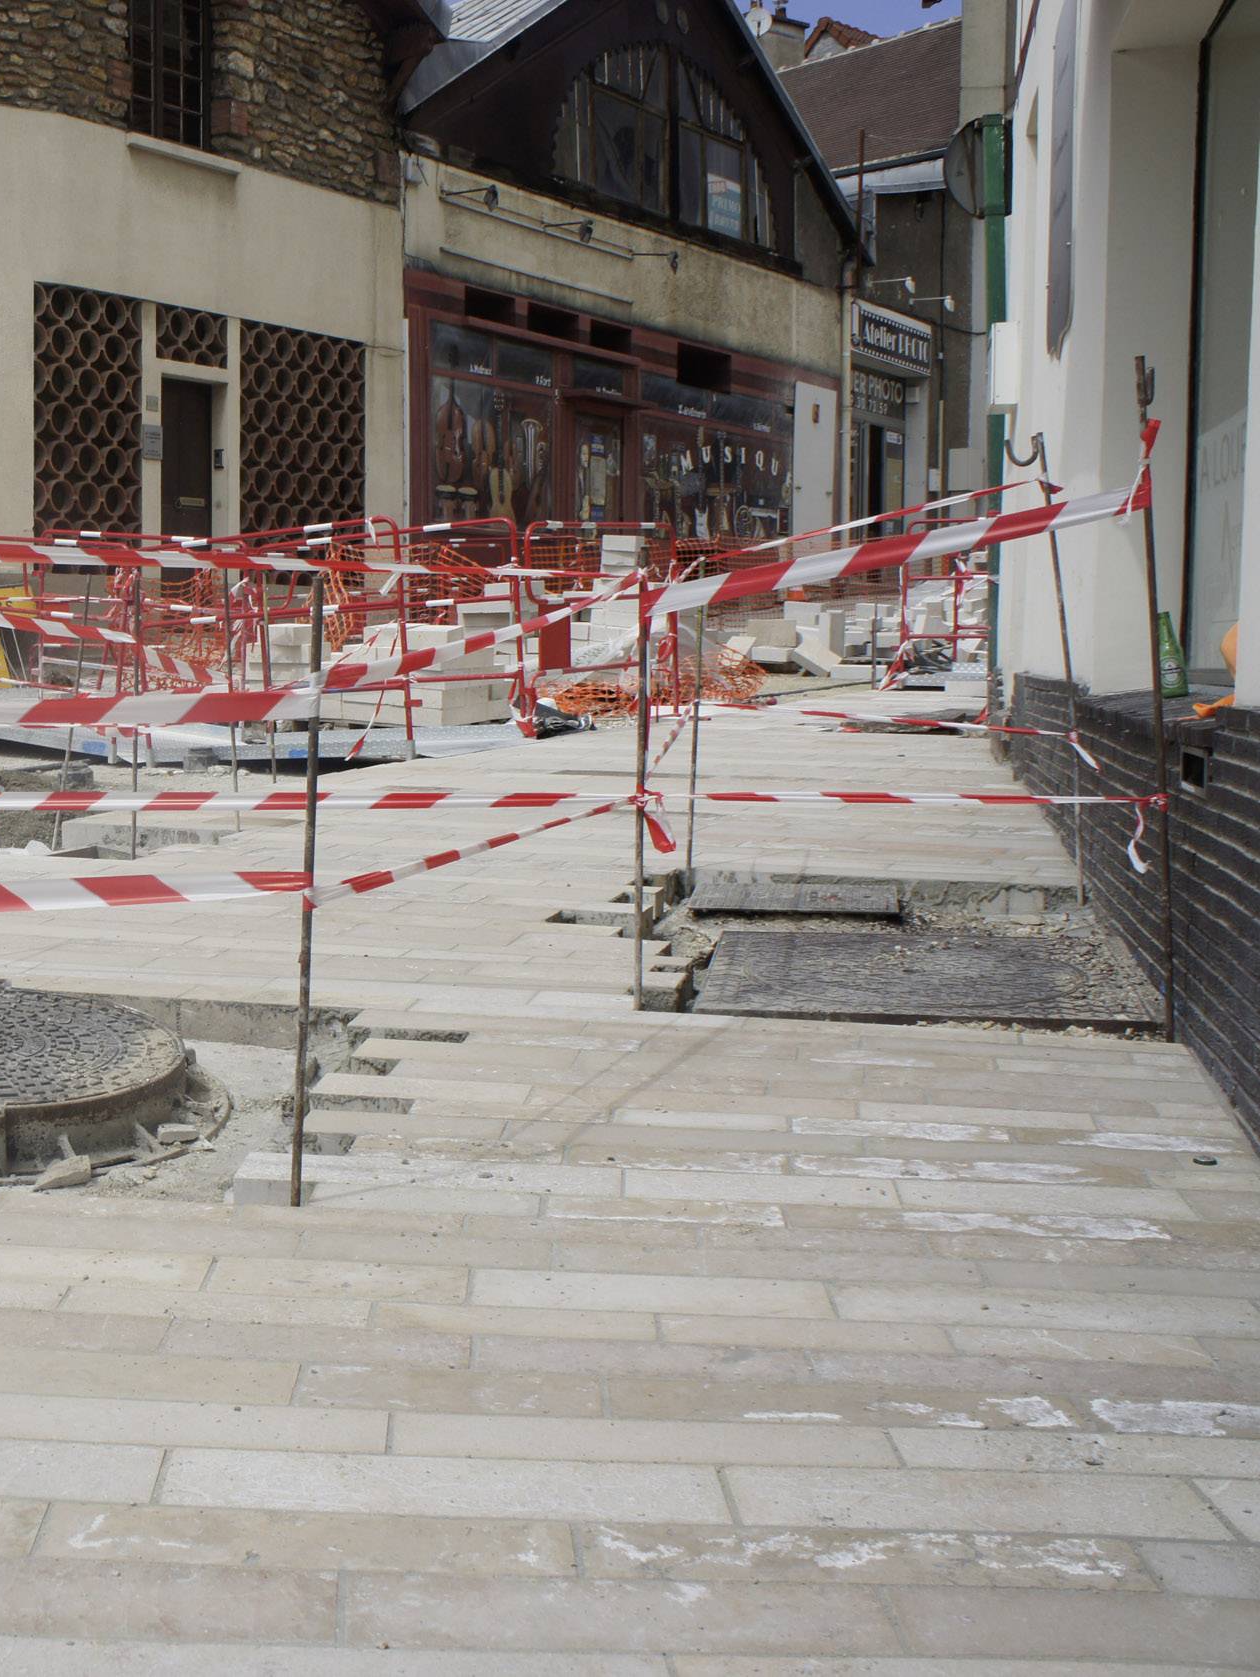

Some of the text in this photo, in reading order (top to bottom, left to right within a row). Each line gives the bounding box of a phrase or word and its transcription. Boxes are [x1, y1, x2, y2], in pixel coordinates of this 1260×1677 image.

[863, 320, 928, 363] Atelier PHOTO
[868, 374, 903, 404] PHOTO
